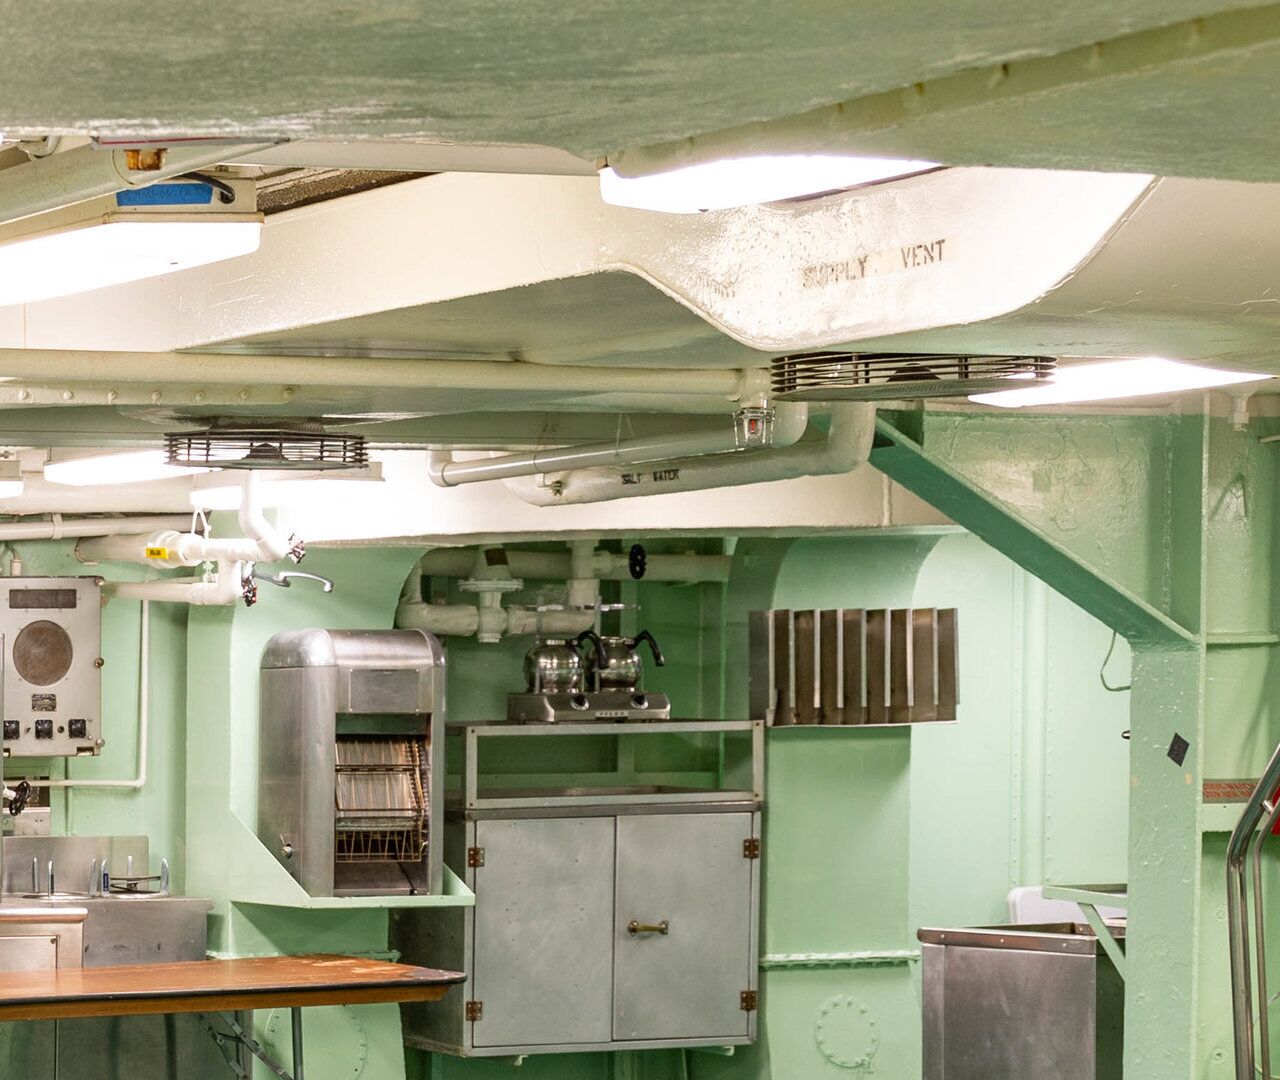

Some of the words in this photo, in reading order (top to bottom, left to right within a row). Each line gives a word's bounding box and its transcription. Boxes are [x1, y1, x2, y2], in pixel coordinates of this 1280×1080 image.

[802, 256, 869, 290] SUPPLY
[901, 239, 945, 269] VENT
[621, 473, 642, 485] SALT
[653, 469, 680, 482] WATER
